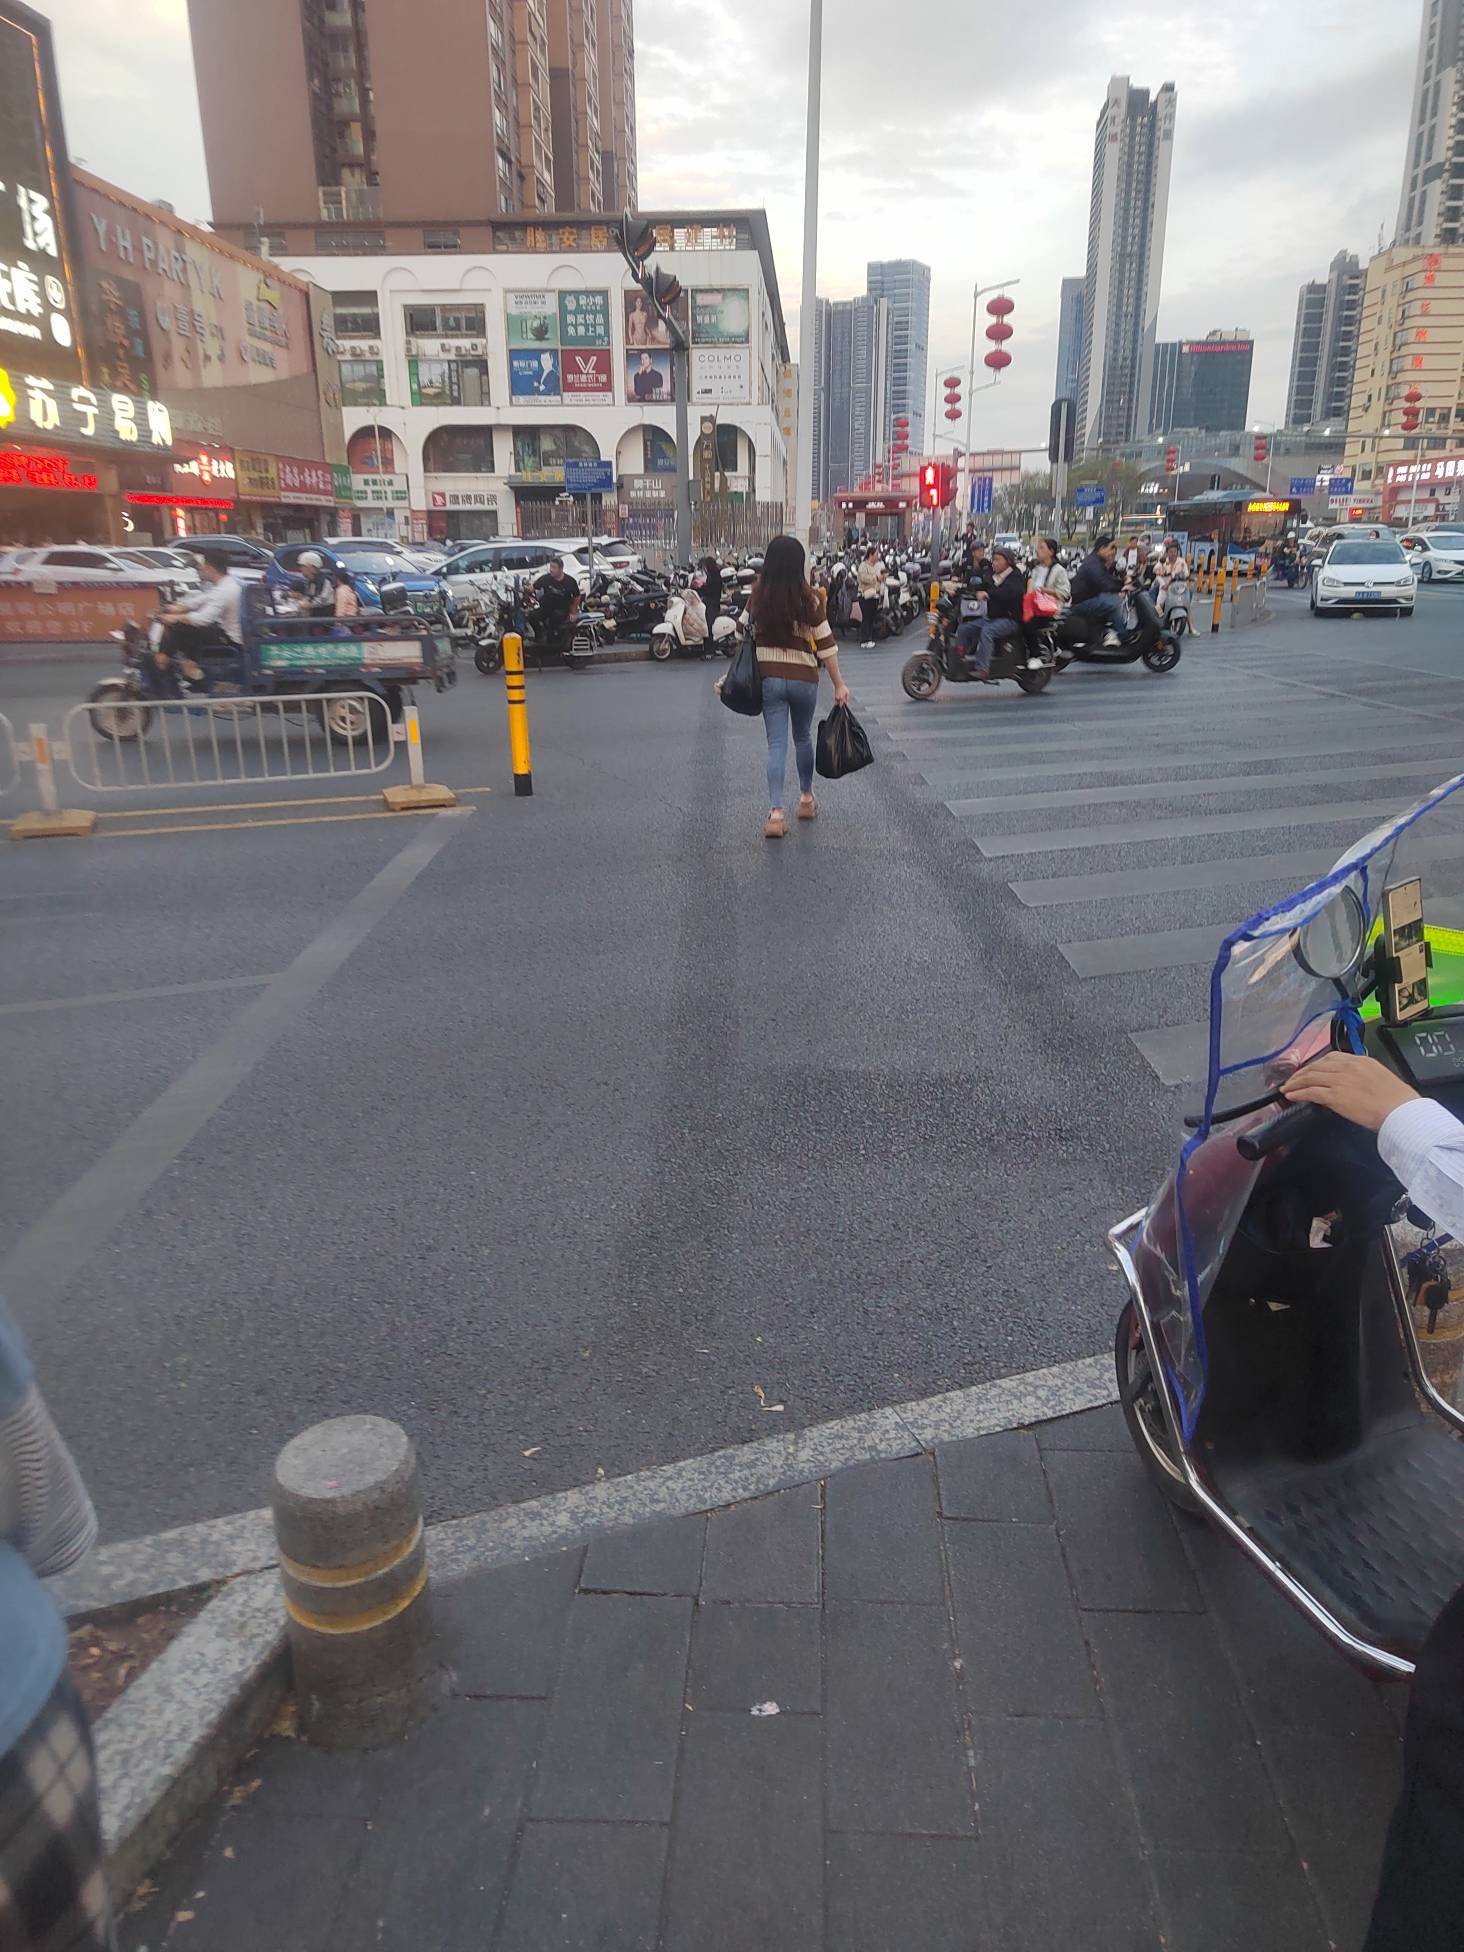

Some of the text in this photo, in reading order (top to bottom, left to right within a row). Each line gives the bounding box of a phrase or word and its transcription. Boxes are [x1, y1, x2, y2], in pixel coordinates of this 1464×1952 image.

[566, 313, 605, 325] 购买饮品
[567, 324, 605, 337] 免费上网
[698, 353, 742, 365] COLMO
[24, 374, 173, 447] 苏宁易购
